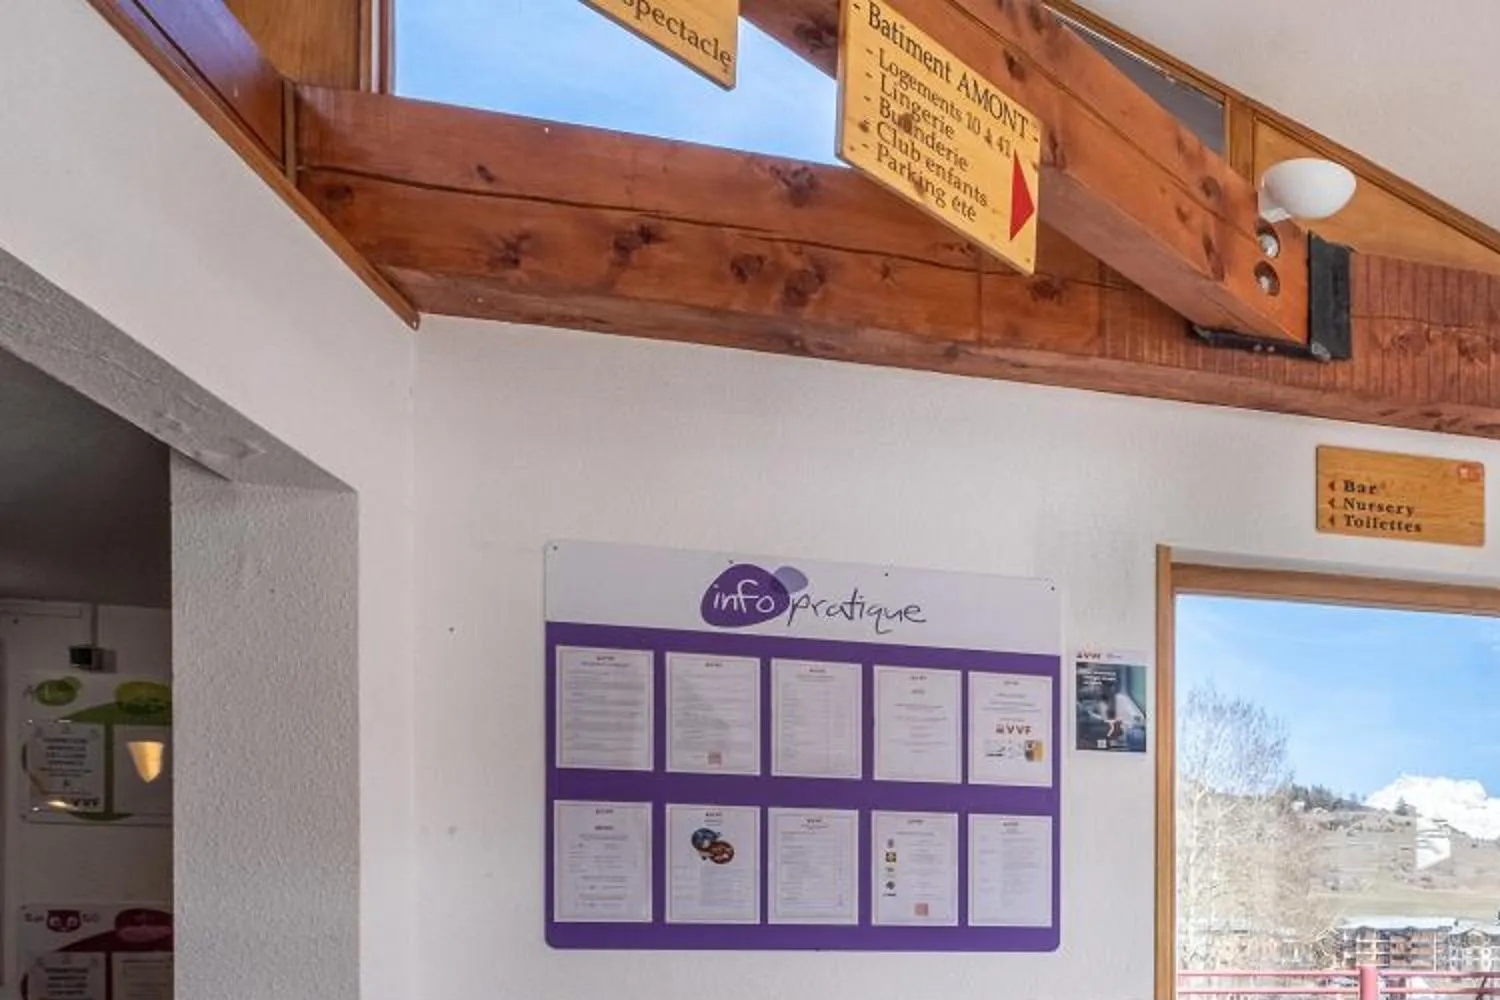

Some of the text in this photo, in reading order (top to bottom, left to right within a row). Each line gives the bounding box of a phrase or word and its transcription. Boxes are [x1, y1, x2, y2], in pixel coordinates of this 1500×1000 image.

[623, 0, 732, 67] pectacle
[868, 1, 1028, 138] Batiment AMONT
[879, 47, 962, 122] Logements
[879, 96, 969, 172] Buanderie
[880, 73, 954, 140] Lingerie
[876, 142, 948, 209] Parking
[877, 121, 988, 207] Club enfants
[1343, 480, 1378, 495] Bar
[1343, 497, 1415, 518] Nursery
[1343, 514, 1423, 533] Toilettes
[712, 579, 928, 635] info pratique
[1006, 724, 1032, 735] VVF
